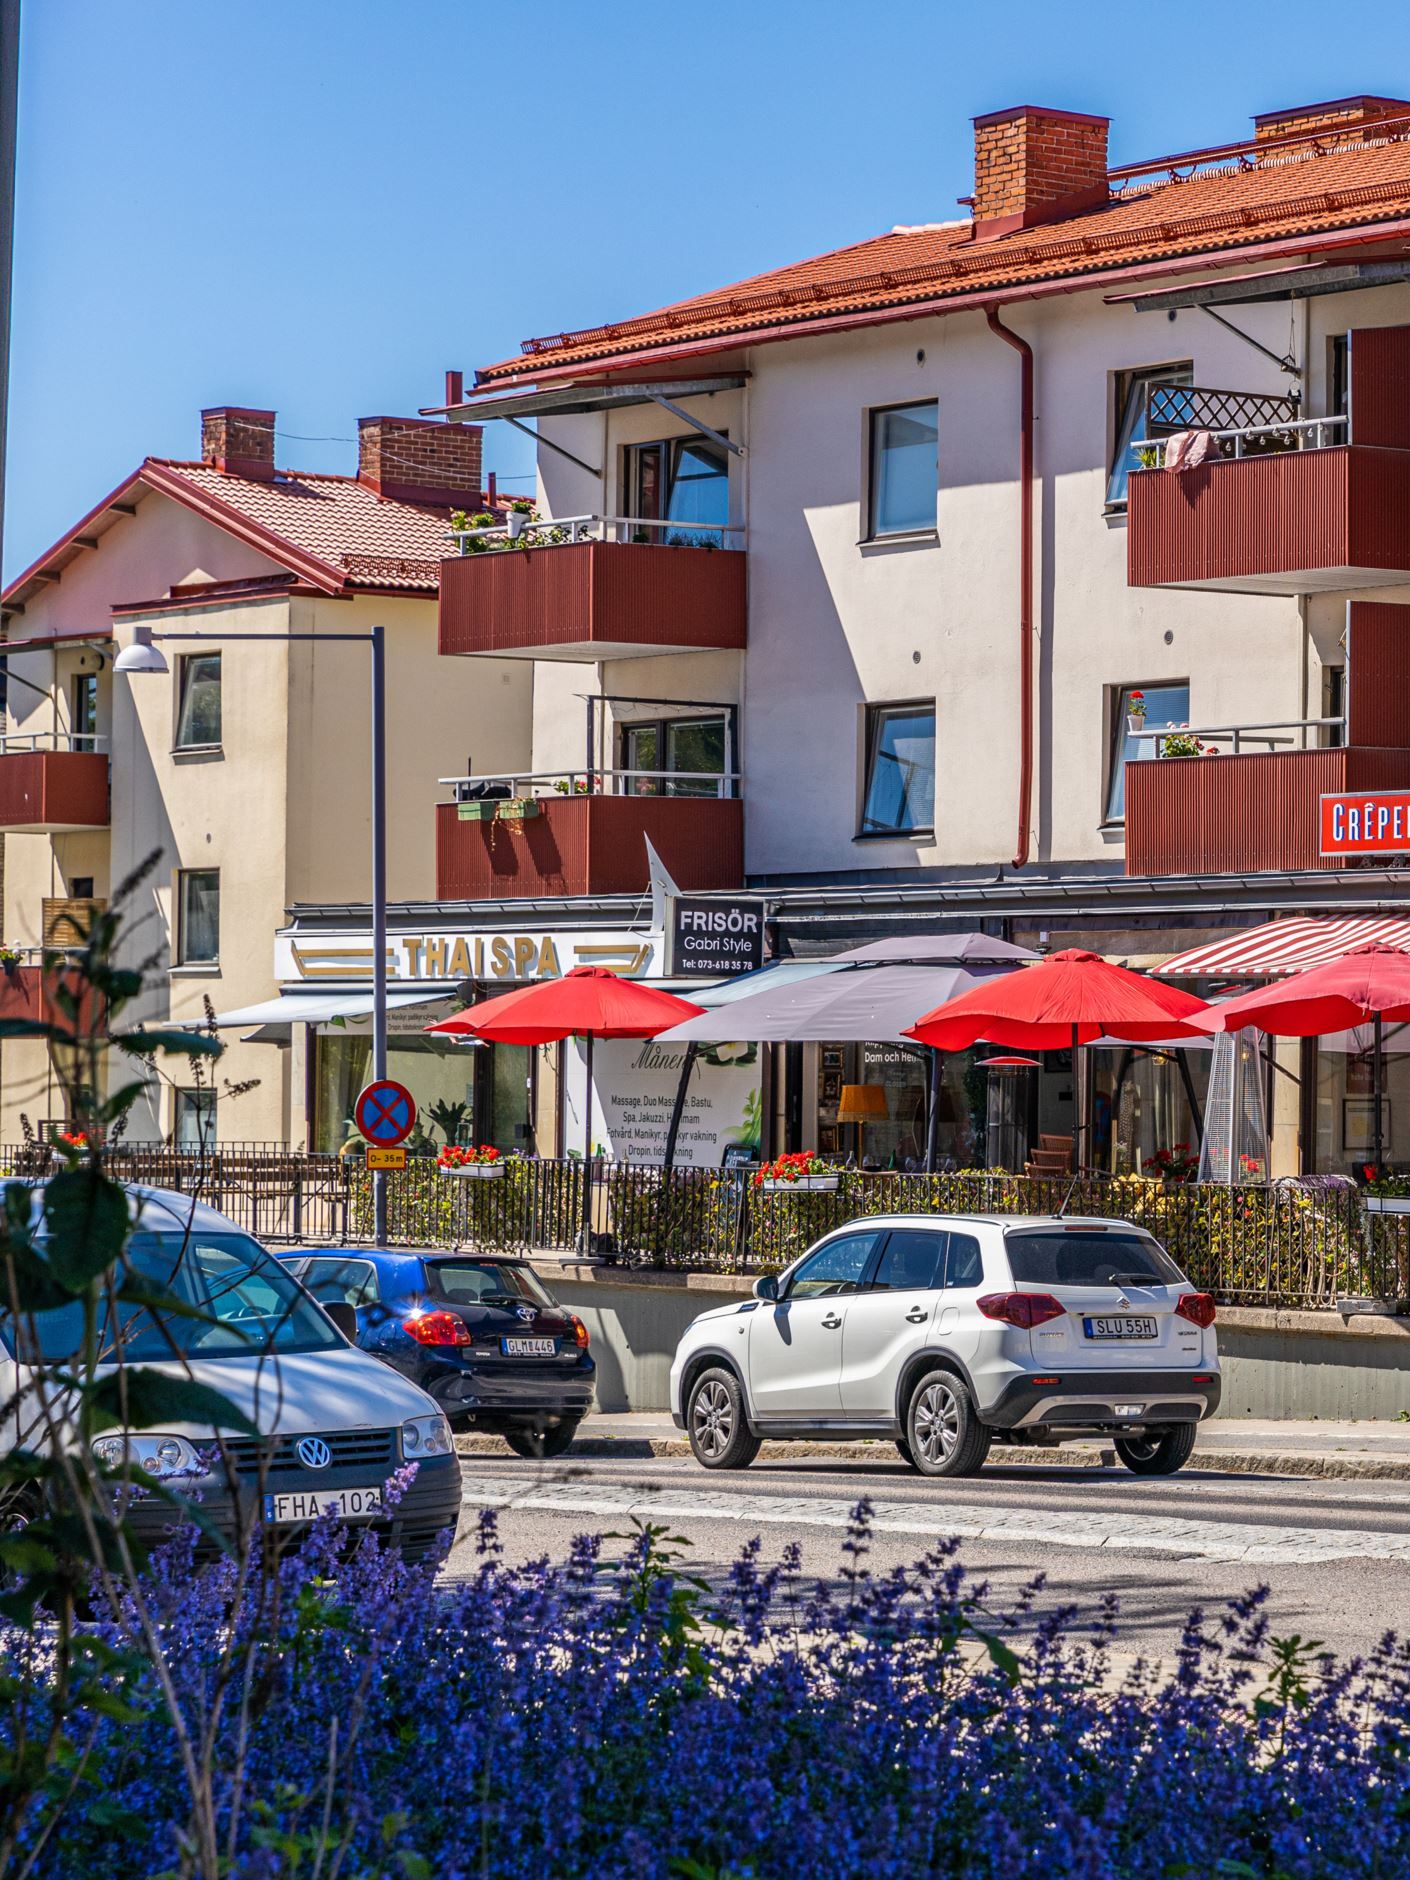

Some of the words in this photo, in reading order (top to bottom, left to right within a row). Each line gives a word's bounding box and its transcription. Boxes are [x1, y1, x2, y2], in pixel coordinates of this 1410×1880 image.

[680, 908, 757, 933] FRISÖR
[684, 936, 720, 950] Gabri
[723, 938, 752, 954] Style
[402, 937, 482, 976] THAI
[491, 936, 559, 976] SPA
[682, 959, 696, 969] Tel:
[698, 959, 730, 969] 073-618
[731, 961, 741, 969] 35
[743, 961, 753, 970] 78
[865, 1052, 882, 1062] Dam
[885, 1051, 899, 1062] och
[611, 1095, 642, 1108] Massage,
[643, 1095, 657, 1106] Duo
[658, 1096, 690, 1108] Masse,
[691, 1096, 713, 1108] Bastu,
[623, 1111, 637, 1124] Spa,
[638, 1112, 665, 1124] Jakuzzi,
[667, 1113, 700, 1124] Hmam
[628, 1145, 653, 1158] Dropin,
[653, 1146, 693, 1160] tidskning
[1097, 1320, 1122, 1334] SLU
[1126, 1319, 1151, 1333] 55H
[509, 1340, 528, 1352] GLM
[534, 1341, 553, 1352] 446
[278, 1496, 320, 1519] FHA
[340, 1491, 377, 1515] 102
